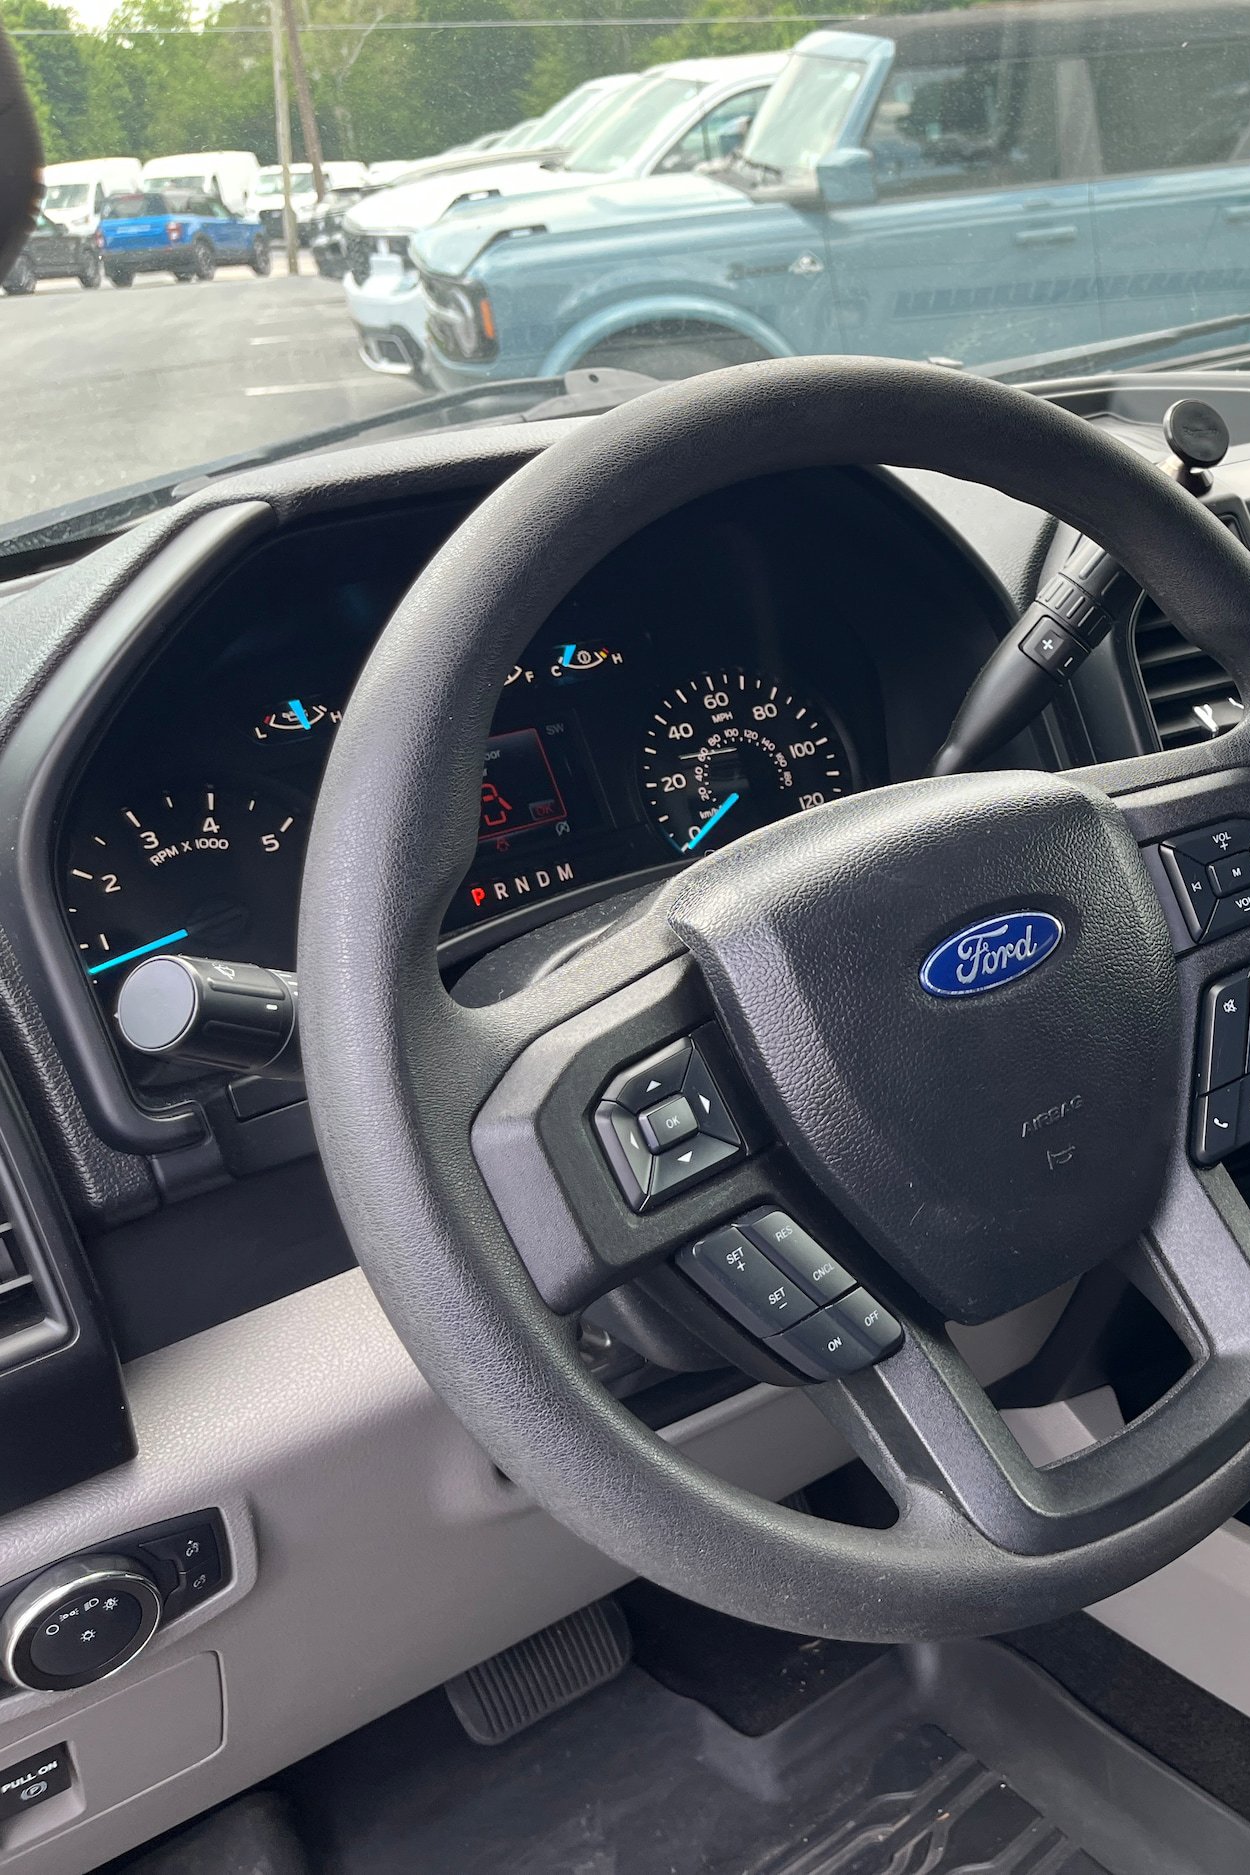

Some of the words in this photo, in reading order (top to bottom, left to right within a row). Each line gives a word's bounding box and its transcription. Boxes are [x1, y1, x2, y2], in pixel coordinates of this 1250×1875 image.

[611, 653, 623, 665] H
[525, 670, 535, 683] F
[551, 665, 562, 677] C
[703, 691, 729, 710] 60
[711, 711, 734, 724] MPH
[752, 703, 778, 721] 80
[255, 726, 267, 739] L
[668, 722, 694, 740] 40
[788, 741, 816, 759] 100
[661, 773, 687, 793] 20
[202, 816, 220, 834] 4
[140, 831, 160, 850] 3
[261, 833, 280, 852] 5
[1212, 832, 1231, 844] VOL
[149, 844, 179, 867] RPM
[181, 840, 193, 852] X
[195, 837, 229, 850] 1000
[1231, 868, 1242, 878] M
[101, 874, 122, 893] 2
[471, 887, 486, 907] P
[493, 882, 510, 900] R
[514, 875, 532, 894] N
[535, 870, 551, 888] D
[556, 863, 575, 882] M
[956, 923, 1037, 984] Ford
[665, 1115, 681, 1129] OK
[774, 1226, 794, 1242] RES
[726, 1246, 745, 1265] SET
[811, 1261, 836, 1282] CNCL
[768, 1287, 787, 1305] SET
[863, 1310, 880, 1328] OFF
[827, 1337, 843, 1353] ON
[1, 1773, 37, 1794] PULL
[38, 1760, 58, 1775] ON
